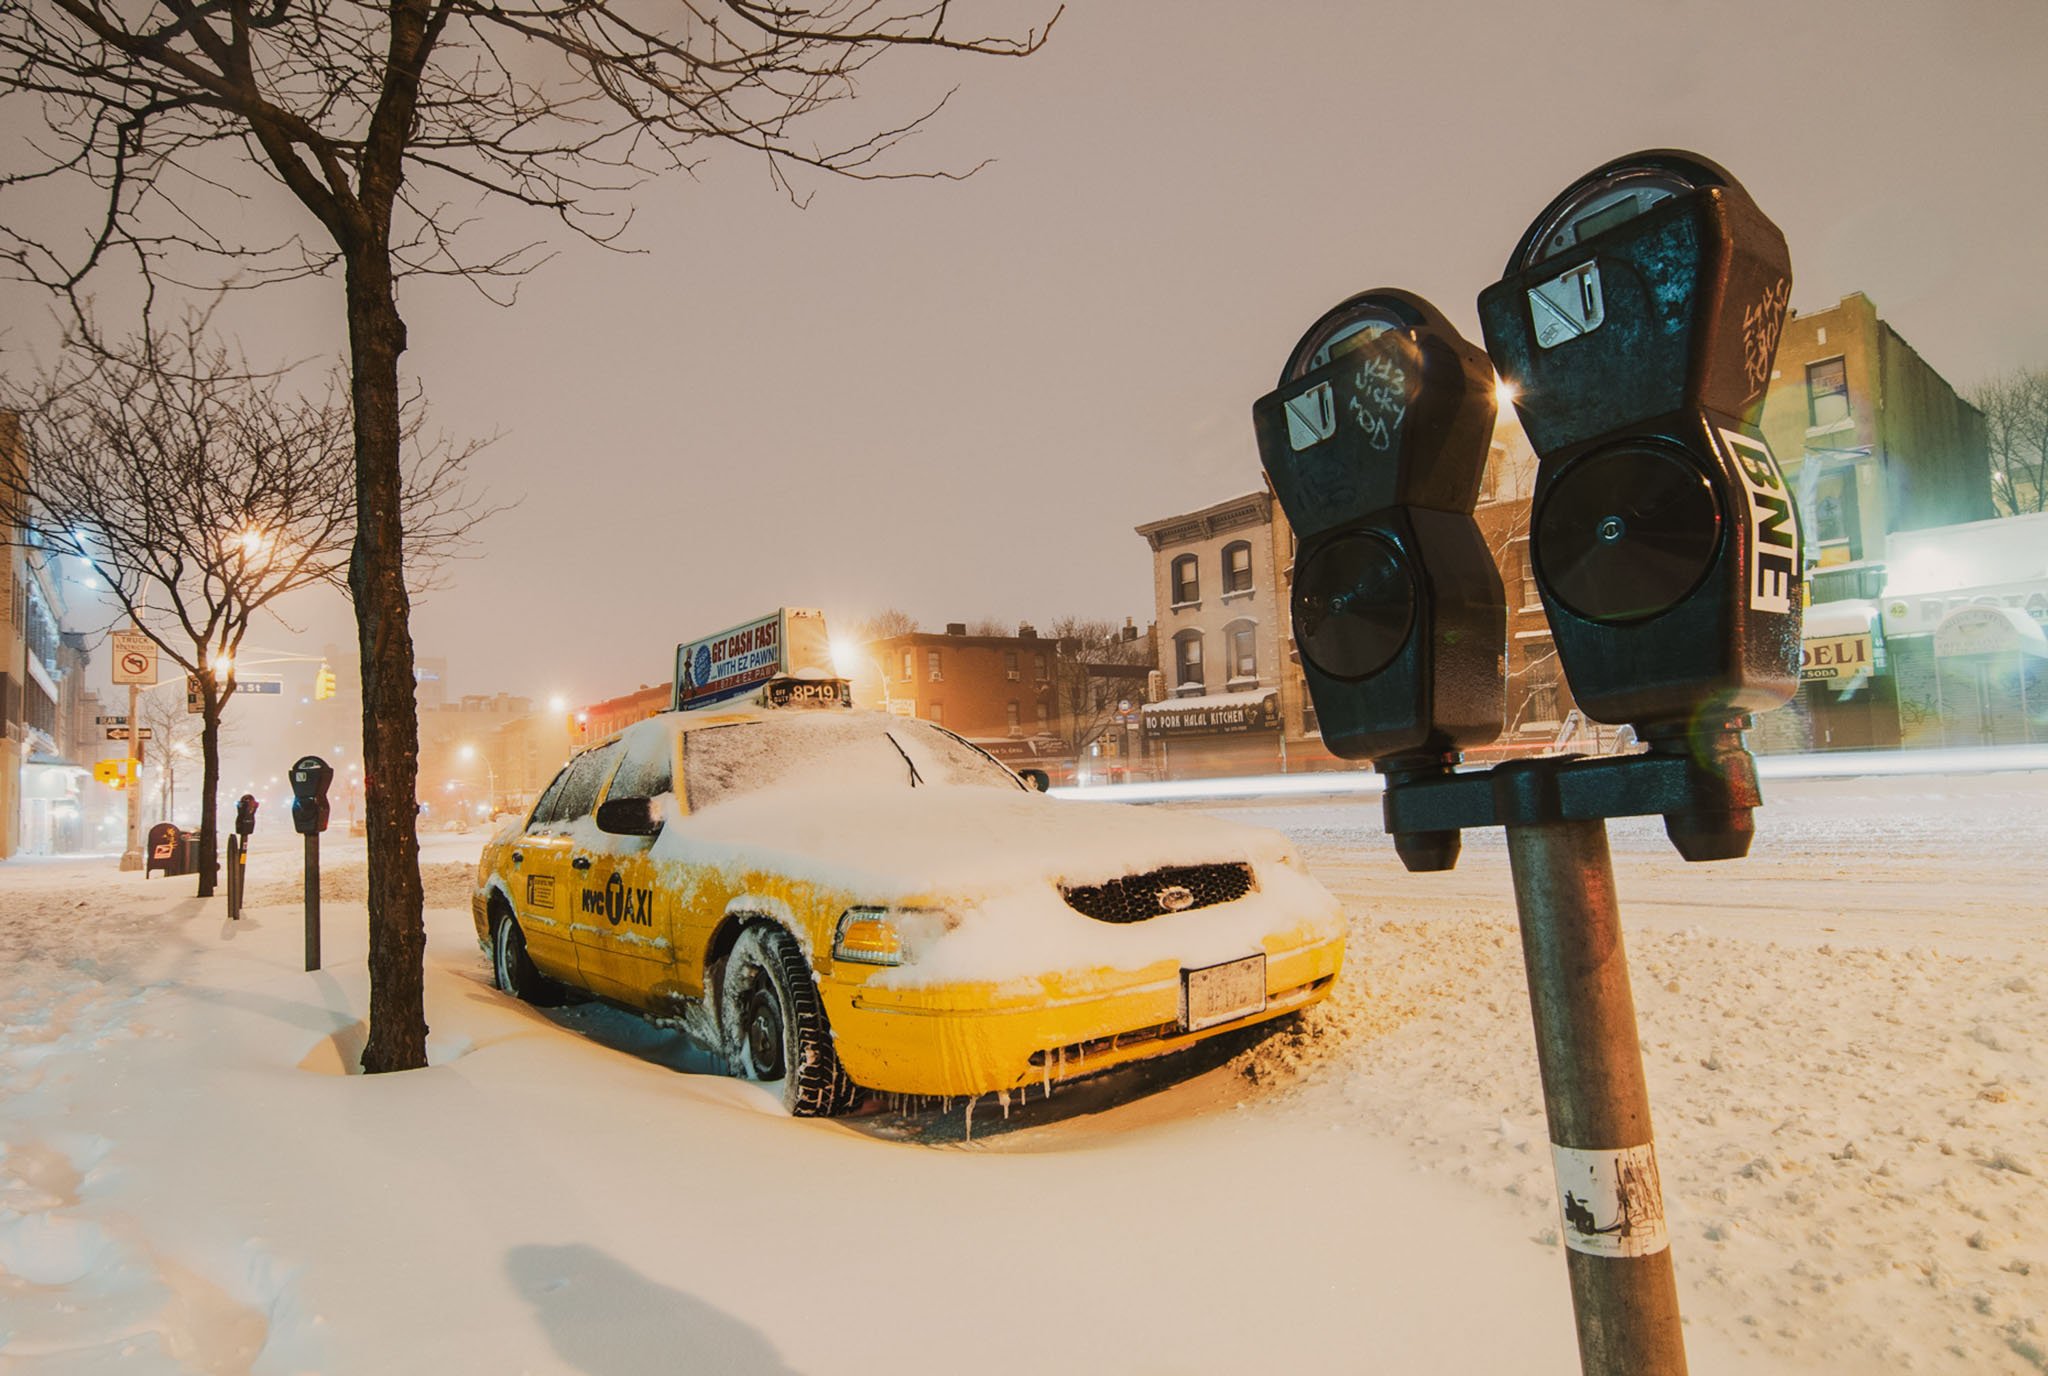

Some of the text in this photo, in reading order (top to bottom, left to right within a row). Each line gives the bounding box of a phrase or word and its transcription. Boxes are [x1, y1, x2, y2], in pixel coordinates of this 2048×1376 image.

[712, 639, 728, 664] GET
[754, 621, 778, 650] FAST
[738, 655, 749, 671] EZ
[750, 646, 778, 668] PAWN!
[1807, 669, 1837, 678] SODA
[793, 685, 834, 702] 8P19
[1146, 716, 1158, 729] NO
[1161, 715, 1181, 729] PORK
[1184, 713, 1207, 727] HALAL
[1210, 709, 1245, 725] KITCHEN
[582, 888, 604, 916] NYC
[607, 877, 653, 927] TAXI
